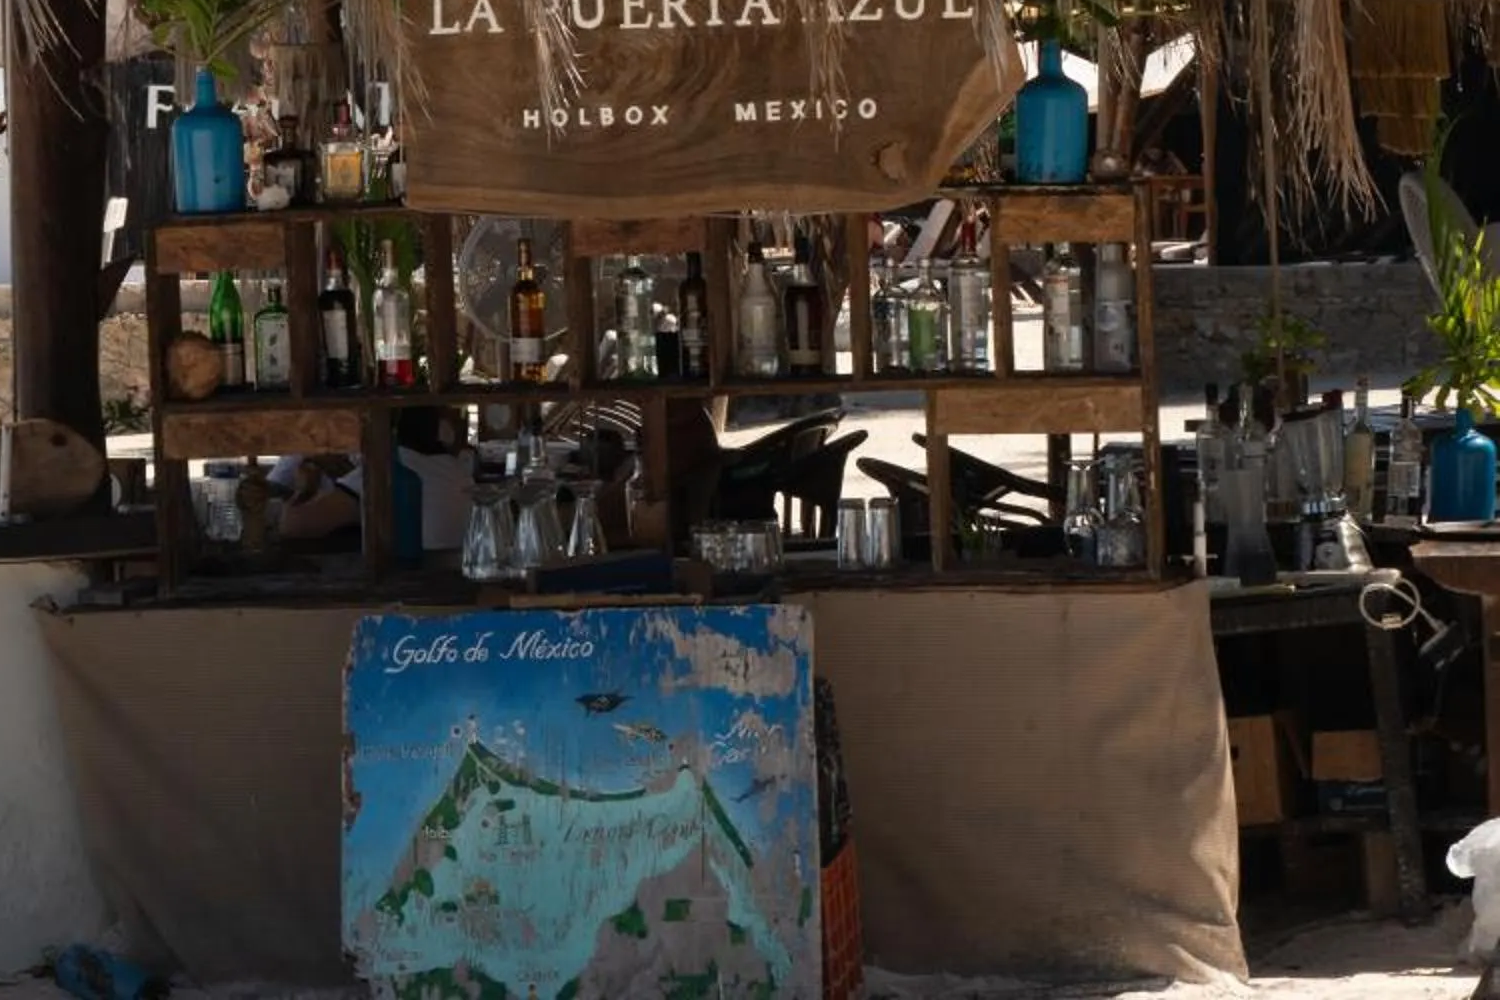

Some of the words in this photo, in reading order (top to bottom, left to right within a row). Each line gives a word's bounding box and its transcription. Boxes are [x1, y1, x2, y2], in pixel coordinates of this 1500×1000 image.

[523, 105, 669, 129] HOLBOX
[734, 98, 877, 122] MEXICO
[384, 634, 459, 674] Golfo
[463, 631, 494, 663] de
[500, 629, 595, 661] México
